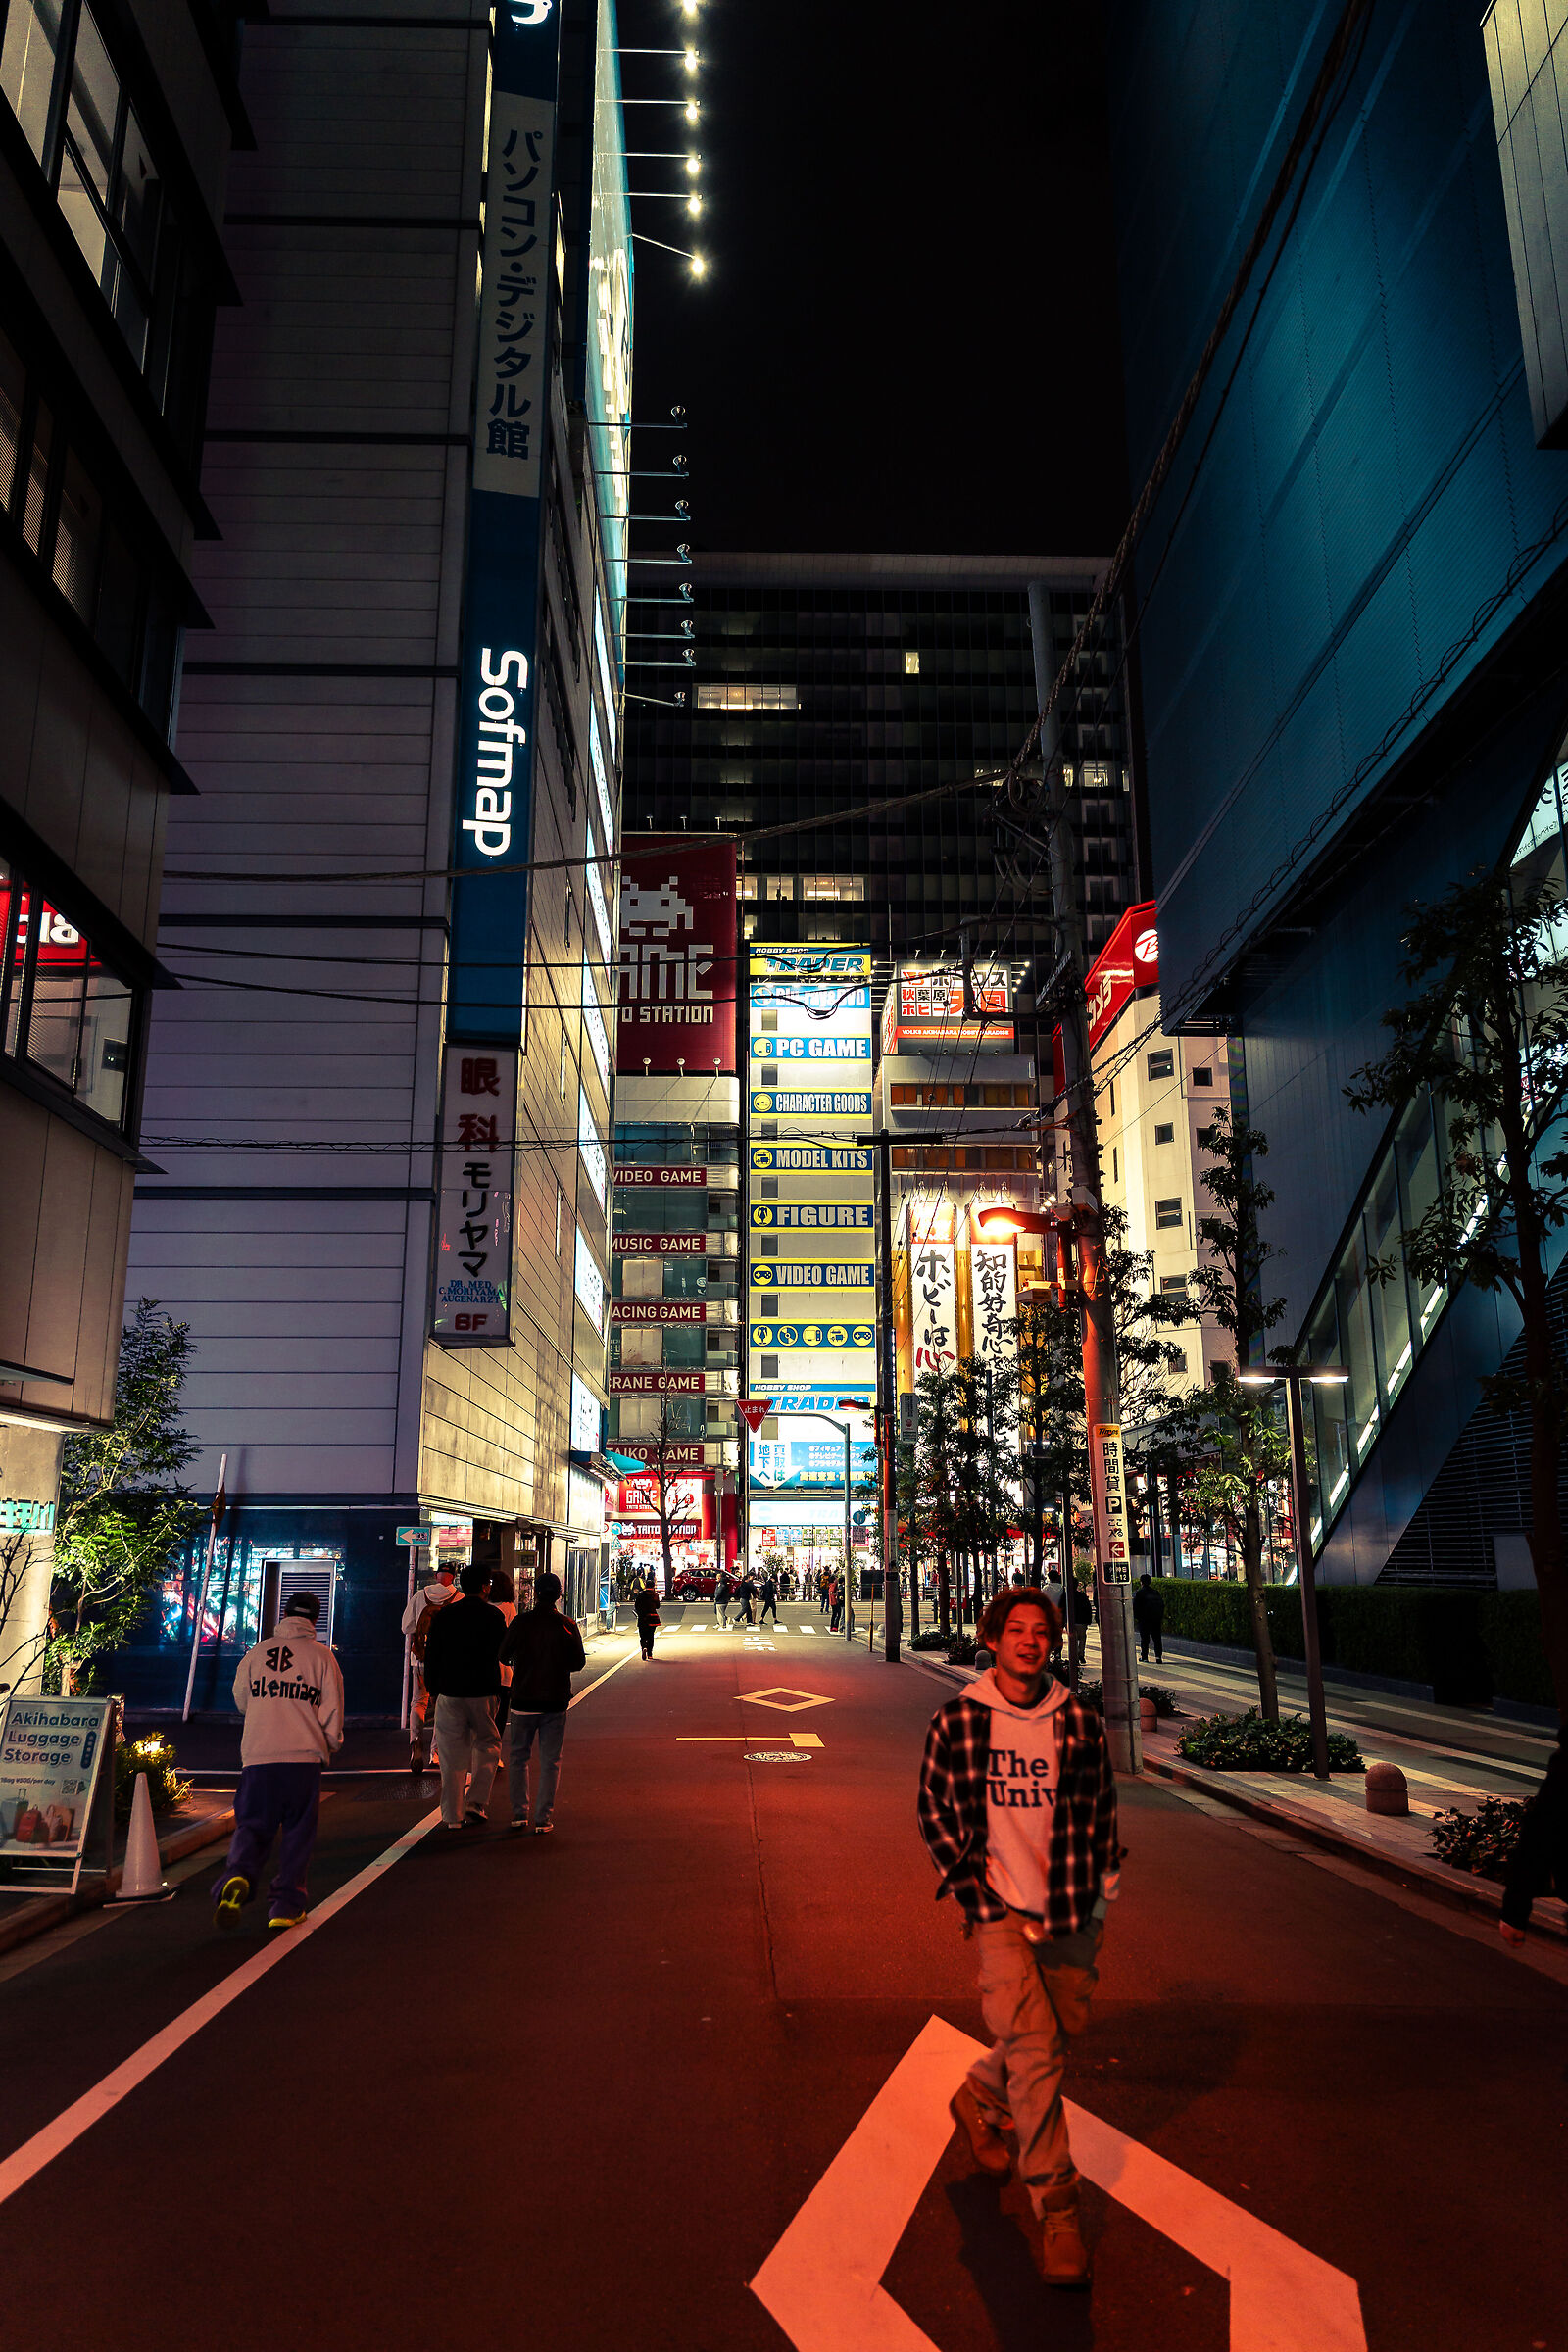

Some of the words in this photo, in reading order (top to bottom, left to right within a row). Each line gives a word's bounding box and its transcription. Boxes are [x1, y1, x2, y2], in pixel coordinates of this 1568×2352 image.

[484, 128, 544, 461] パソコン・デジタル館
[462, 647, 529, 857] Sofmap
[618, 943, 714, 1000] AME
[765, 956, 864, 973] TRADER
[902, 988, 947, 1002] 秋葉原
[639, 1006, 713, 1023] STATION
[902, 1003, 947, 1016] ホビー
[776, 1038, 805, 1057] PC
[808, 1038, 867, 1057] GAME
[775, 1093, 833, 1113] CHARACTER
[834, 1093, 867, 1113] GOODS
[776, 1149, 829, 1169] MODEL
[831, 1149, 868, 1169] KITS
[661, 1170, 702, 1183] GAME
[776, 1206, 869, 1226] FIGURE
[659, 1238, 701, 1250] GAME
[775, 1265, 822, 1285] VIDEO
[825, 1265, 870, 1285] GAME
[612, 1306, 657, 1319] ACING
[659, 1306, 701, 1319] GAME
[658, 1376, 700, 1389] GAME
[744, 1405, 765, 1414] 止まれ
[1099, 1427, 1119, 1437] Times
[657, 1447, 699, 1461] AME
[758, 1444, 770, 1480] 地下へ
[1102, 1441, 1121, 1493] 時間貸
[11, 1712, 100, 1727] Akihabara
[7, 1730, 81, 1747] Luggage
[3, 1747, 72, 1766] Storage
[988, 1749, 1049, 1778] The
